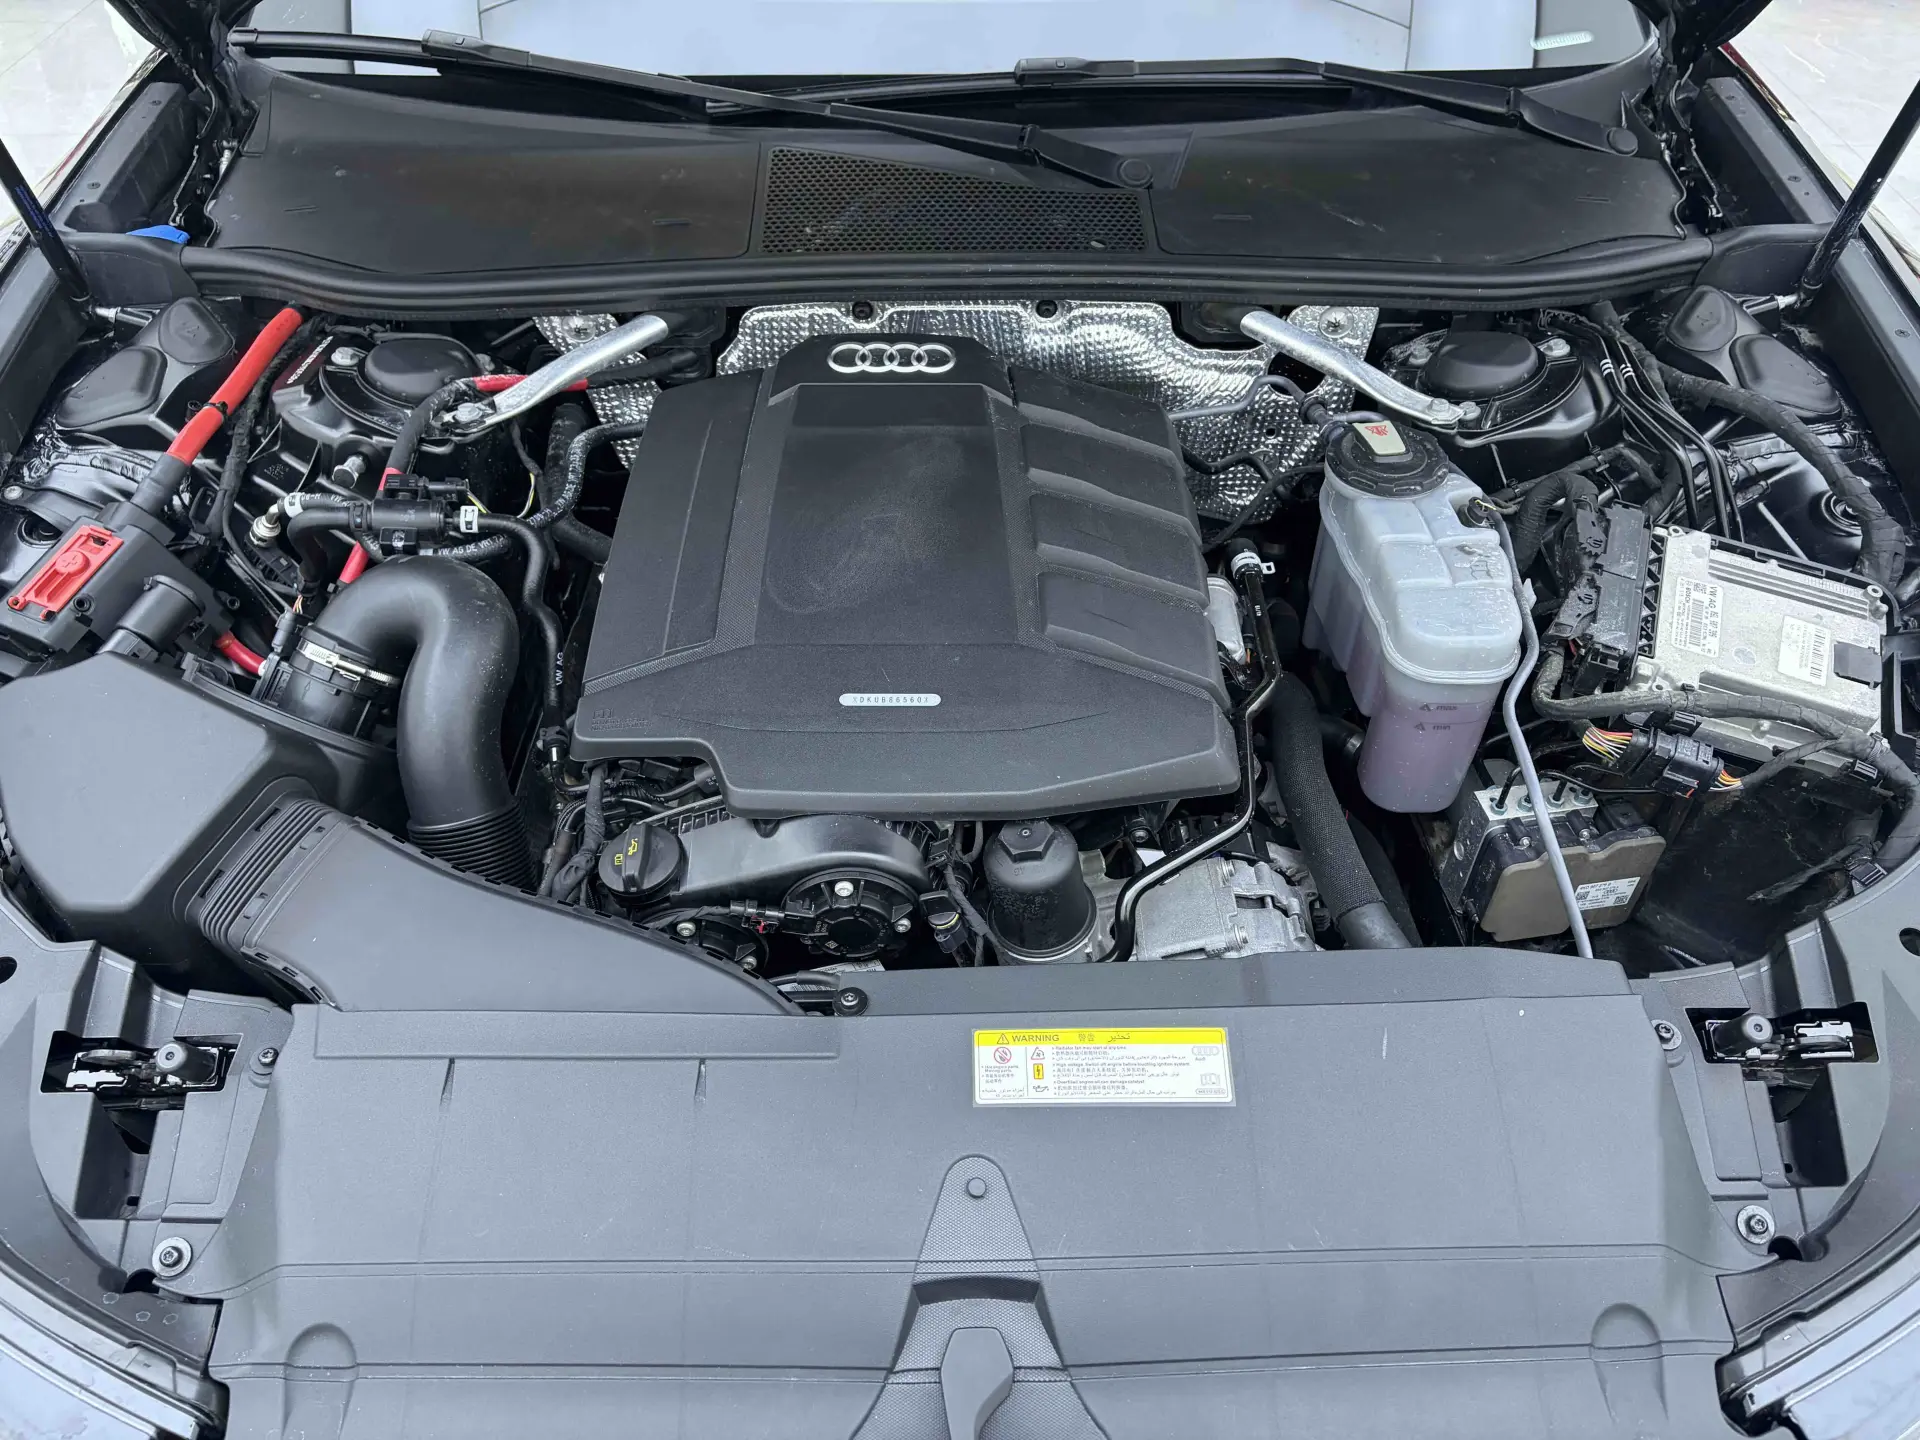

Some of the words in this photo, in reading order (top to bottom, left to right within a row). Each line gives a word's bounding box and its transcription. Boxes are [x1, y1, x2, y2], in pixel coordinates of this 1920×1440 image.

[438, 547, 450, 556] VW
[452, 546, 464, 555] AG
[465, 543, 478, 553] DE
[477, 537, 492, 549] VRT
[1708, 598, 1717, 609] AG
[556, 651, 564, 666] AG
[555, 669, 564, 686] VW
[1012, 1034, 1060, 1043] WARNING
